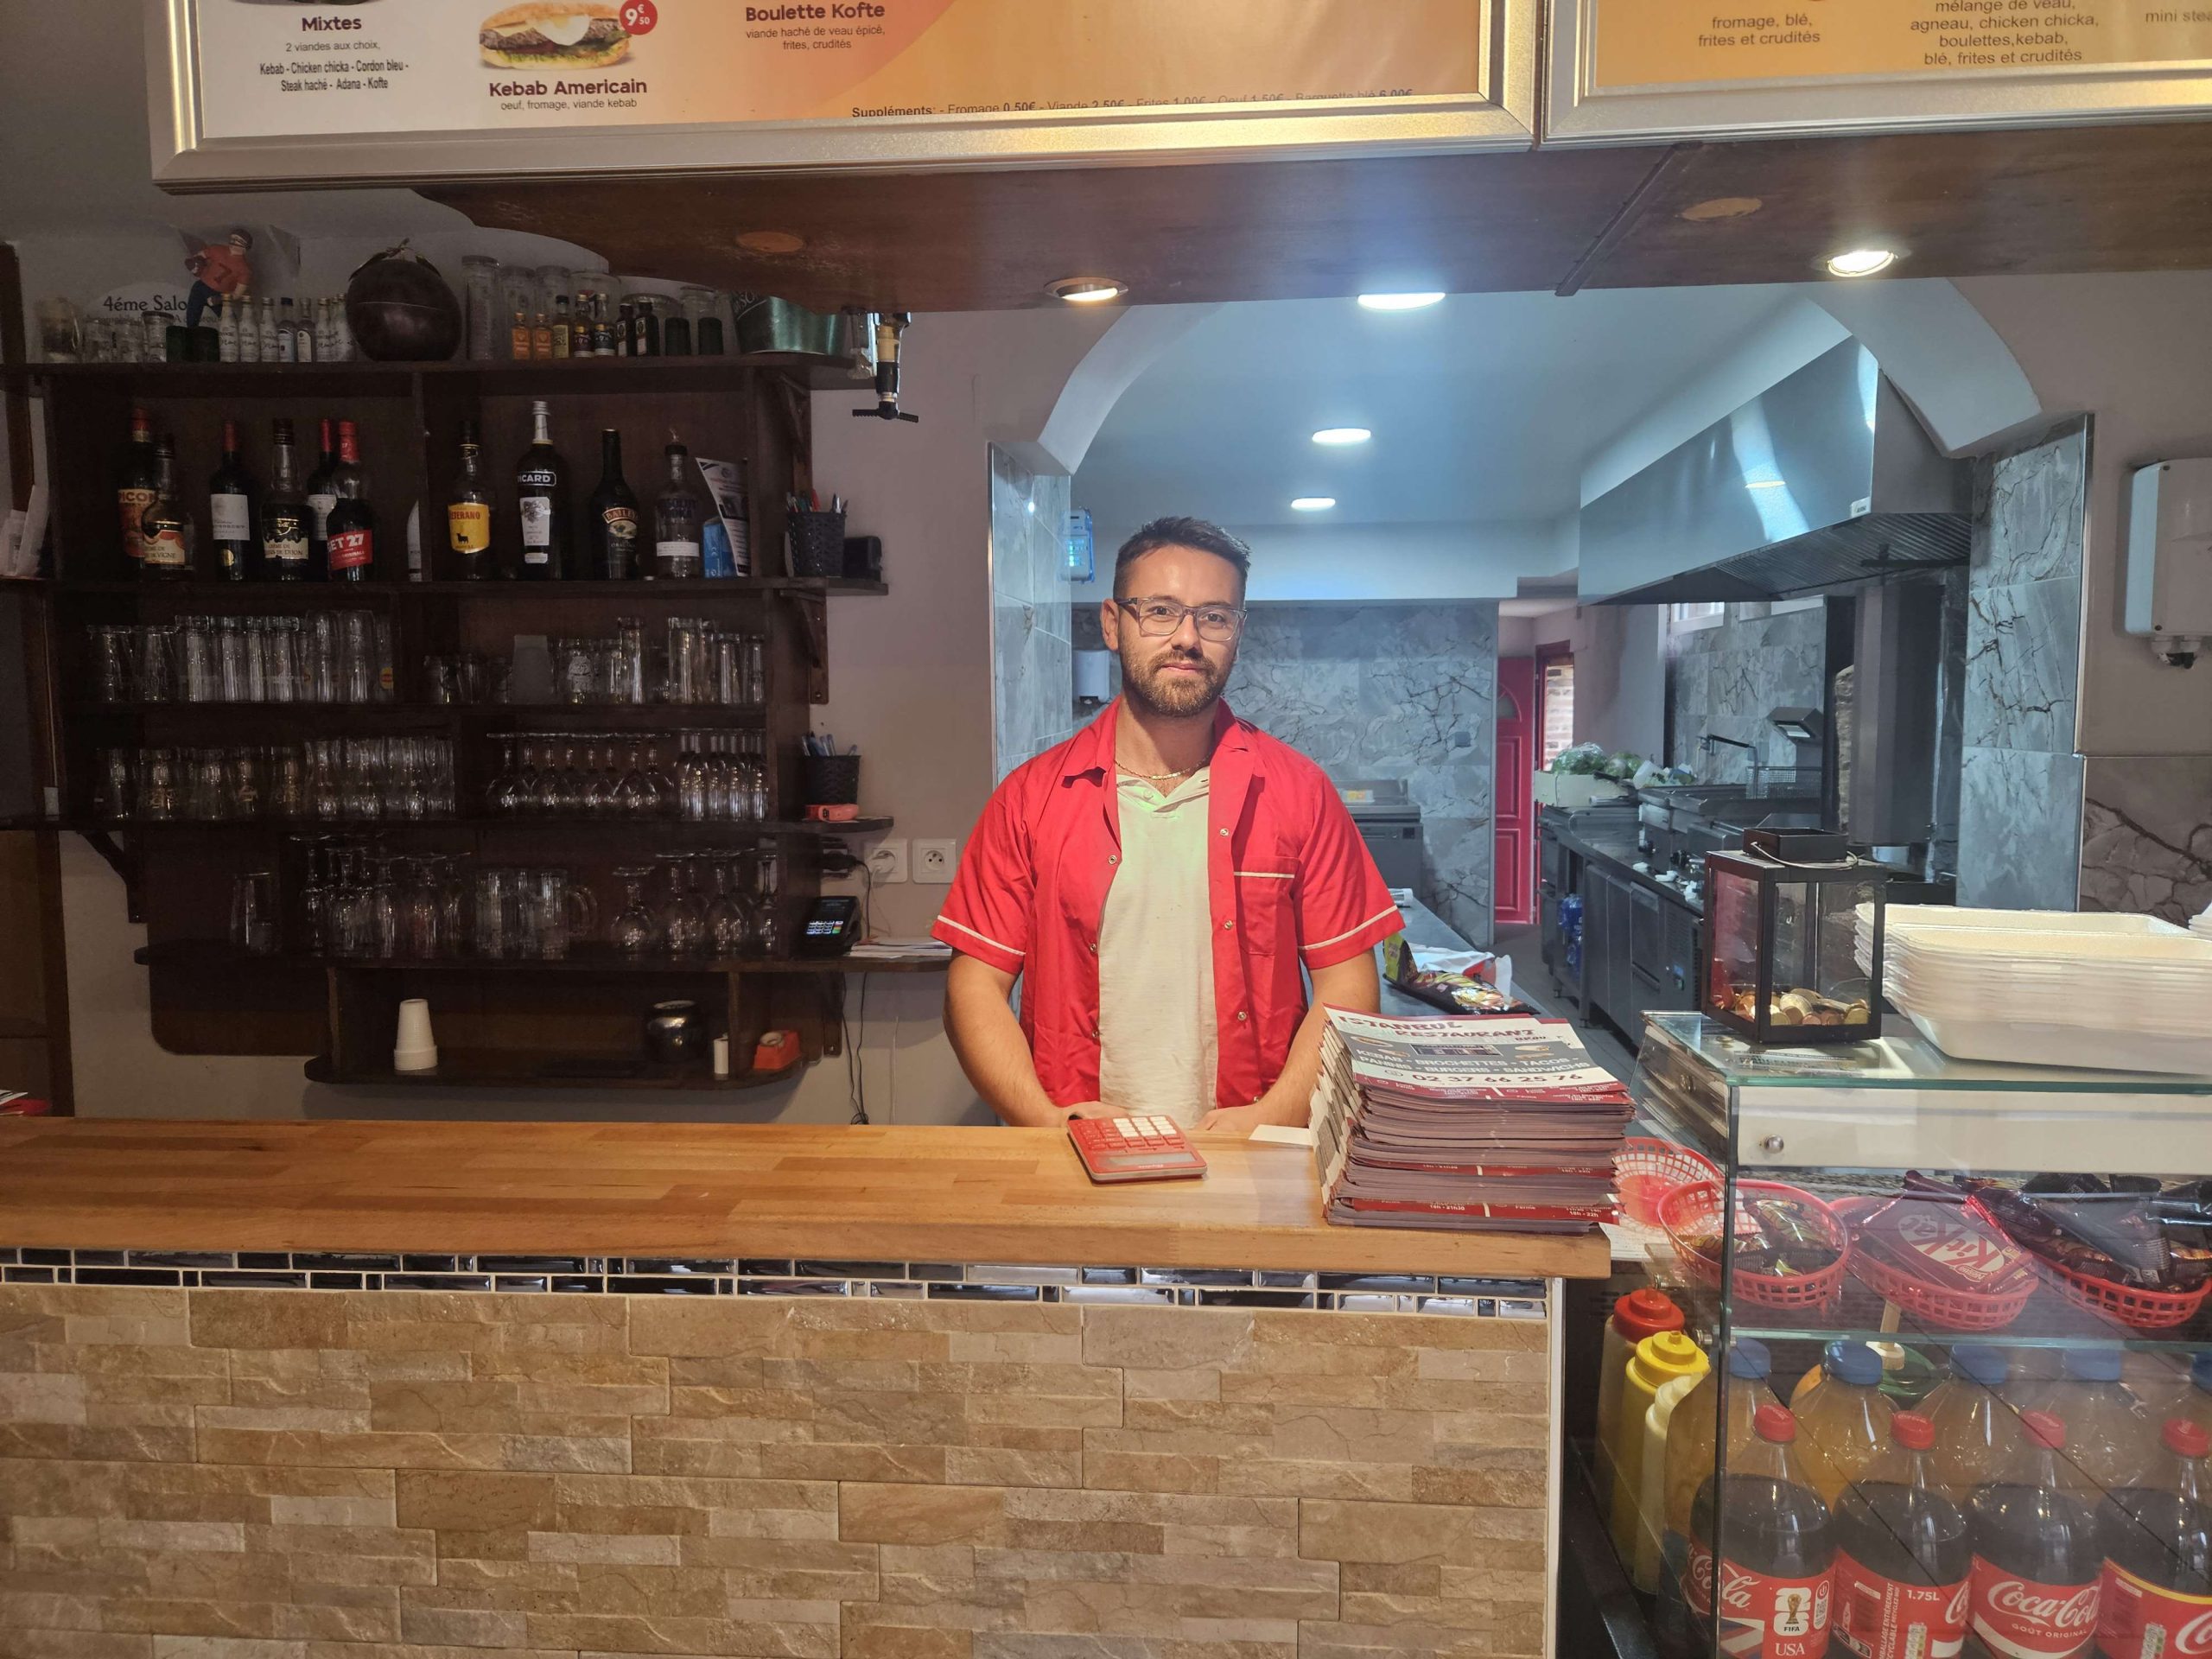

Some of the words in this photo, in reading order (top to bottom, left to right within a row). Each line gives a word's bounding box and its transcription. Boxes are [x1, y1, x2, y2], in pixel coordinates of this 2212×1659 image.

[746, 4, 826, 22] Boulette
[832, 2, 885, 18] Kofte
[1936, 0, 2002, 14] mélange
[2008, 0, 2027, 10] de
[2033, 0, 2075, 10] veau,
[1713, 16, 1779, 30] fromage,
[1785, 13, 1813, 26] blé,
[1910, 19, 1974, 34] agneau,
[1980, 15, 2039, 29] chicken
[2044, 13, 2099, 28] chicka,
[2145, 9, 2177, 22] mini
[2183, 10, 2212, 22] stea
[302, 16, 362, 32] Mixtes
[746, 29, 778, 39] viande
[780, 26, 810, 37] haché
[814, 26, 825, 36] de
[829, 27, 853, 36] veau
[855, 24, 886, 37] épicé,
[285, 43, 292, 52] 2
[295, 41, 331, 52] viandes
[353, 40, 381, 50] choix,
[783, 40, 810, 50] frites,
[812, 38, 852, 49] crudités
[1699, 34, 1735, 47] frites
[1740, 33, 1754, 45] et
[1759, 30, 1821, 45] crudités
[1923, 52, 1951, 66] blé,
[1957, 52, 1995, 65] frites
[2000, 52, 2015, 63] et
[2020, 48, 2083, 62] crudités
[259, 63, 285, 75] Kebab
[290, 60, 322, 74] Chicken
[324, 60, 349, 73] chicka
[356, 60, 385, 73] Cordon
[386, 59, 404, 72] bleu
[281, 79, 302, 92] Steak
[304, 78, 328, 91] haché
[336, 78, 361, 90] Adana
[367, 76, 388, 89] Kofte
[489, 79, 548, 97] Kebab
[554, 78, 647, 95] Americain
[500, 99, 524, 111] oeuf,
[527, 98, 570, 111] fromage,
[573, 98, 605, 109] viande
[607, 97, 638, 108] kebab
[103, 295, 149, 311] 4éme
[153, 294, 188, 311] Salo
[606, 508, 643, 520] BAILEY
[346, 533, 365, 548] 27
[1338, 1015, 1464, 1031] ISTANBUL
[1395, 1028, 1536, 1038] RESTAURANT
[1357, 1049, 1403, 1063] KEBAB
[1414, 1058, 1508, 1067] BROCHETTES
[1518, 1058, 1569, 1067] TACOS
[1360, 1056, 1413, 1071] PANINIS
[1503, 1062, 1590, 1073] SANDWICHS
[1412, 1074, 1443, 1083] 02
[1484, 1074, 1511, 1083] 66
[1553, 1073, 1584, 1082] 76
[1906, 1589, 1941, 1602] 1.75L
[1986, 1580, 2100, 1629] Coca-Col
[2011, 1623, 2042, 1637] GOÛT
[2044, 1628, 2088, 1639] ORIGINAL
[1776, 1643, 1805, 1656] USA
